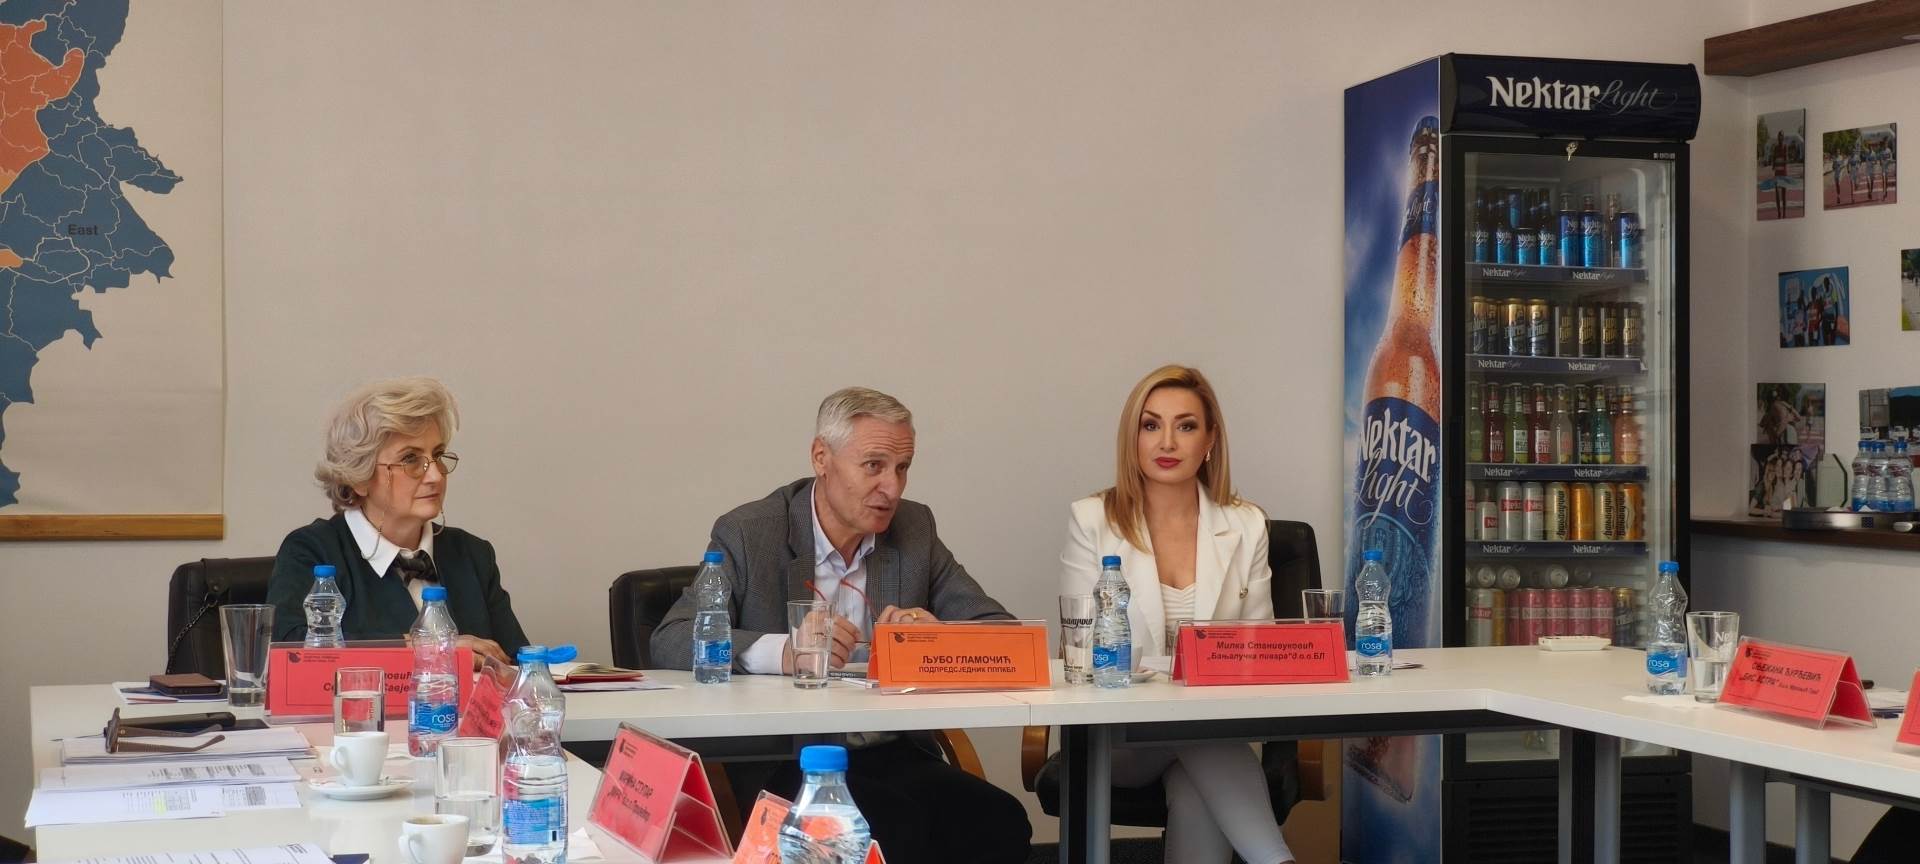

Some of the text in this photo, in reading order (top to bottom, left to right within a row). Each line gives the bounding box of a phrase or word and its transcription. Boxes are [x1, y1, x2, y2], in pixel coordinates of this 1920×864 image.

[1486, 76, 1678, 116] Nektar Light
[68, 224, 98, 236] East
[1482, 267, 1511, 277] Nektar
[1572, 271, 1600, 280] Nektar
[1478, 359, 1506, 369] Nektar
[1567, 362, 1596, 371] Nektar
[1360, 407, 1436, 482] Nektar
[1483, 467, 1513, 477] Nektar
[1573, 468, 1602, 478] Nektar
[1359, 448, 1434, 529] Light
[1482, 544, 1511, 554] Nektar
[1572, 545, 1600, 553] Nektar
[1216, 641, 1314, 651] Милка Станивуковић
[1361, 642, 1383, 650] rosa
[922, 655, 1011, 664] ЉУБО ГЛАМОЧИЋ
[1648, 659, 1670, 669] rosa
[918, 666, 986, 674] ПОДПРЕДСЈЕДНИК
[431, 713, 456, 724] rosa
